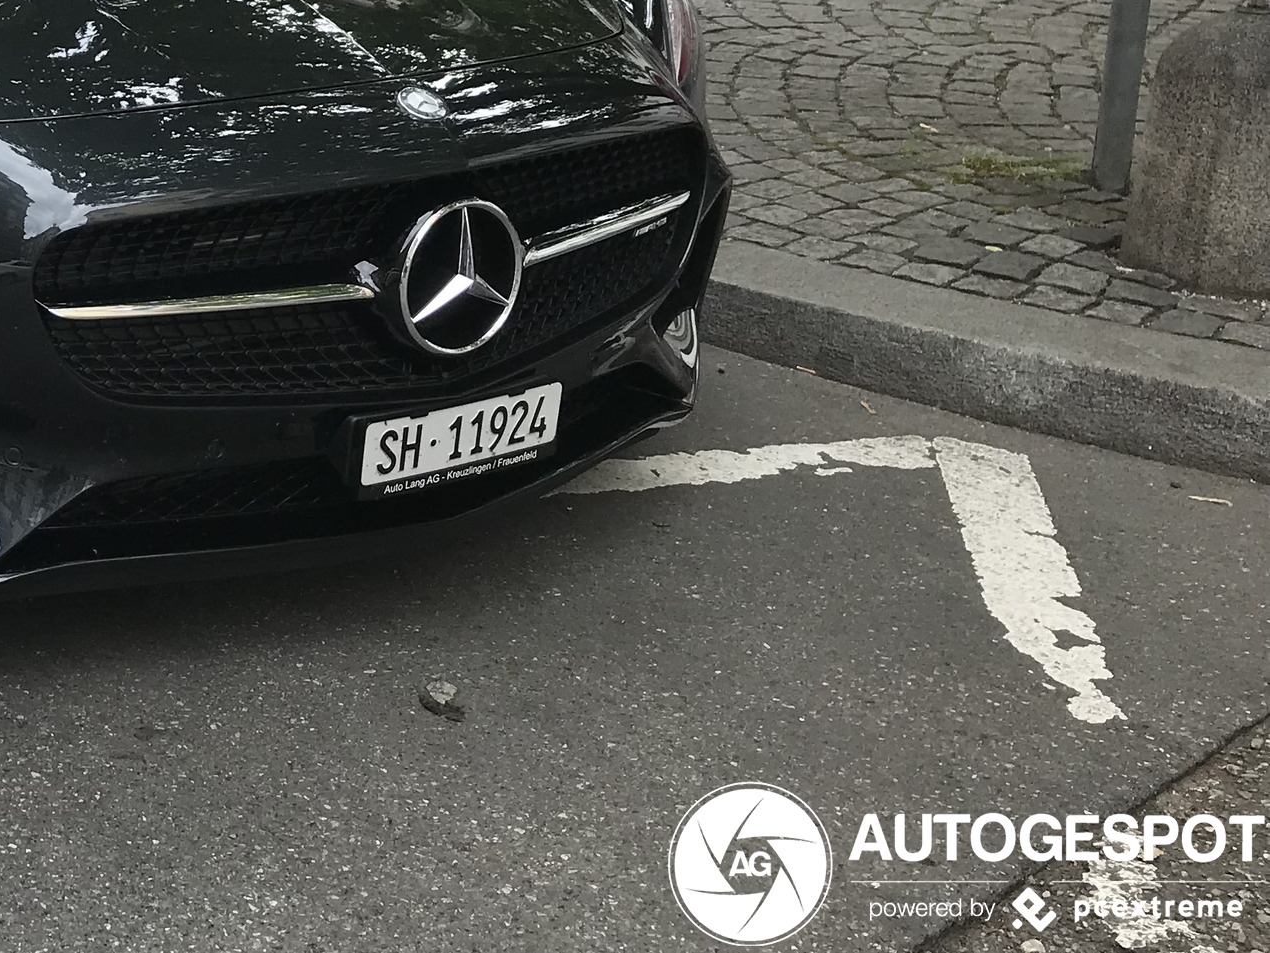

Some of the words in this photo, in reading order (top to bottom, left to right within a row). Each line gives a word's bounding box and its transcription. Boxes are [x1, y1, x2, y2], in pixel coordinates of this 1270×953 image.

[383, 484, 404, 495] Auto
[405, 480, 426, 490] Lang
[426, 474, 440, 485] AG
[446, 463, 492, 480] Kreuzlingen
[497, 449, 538, 467] Frauenfeld
